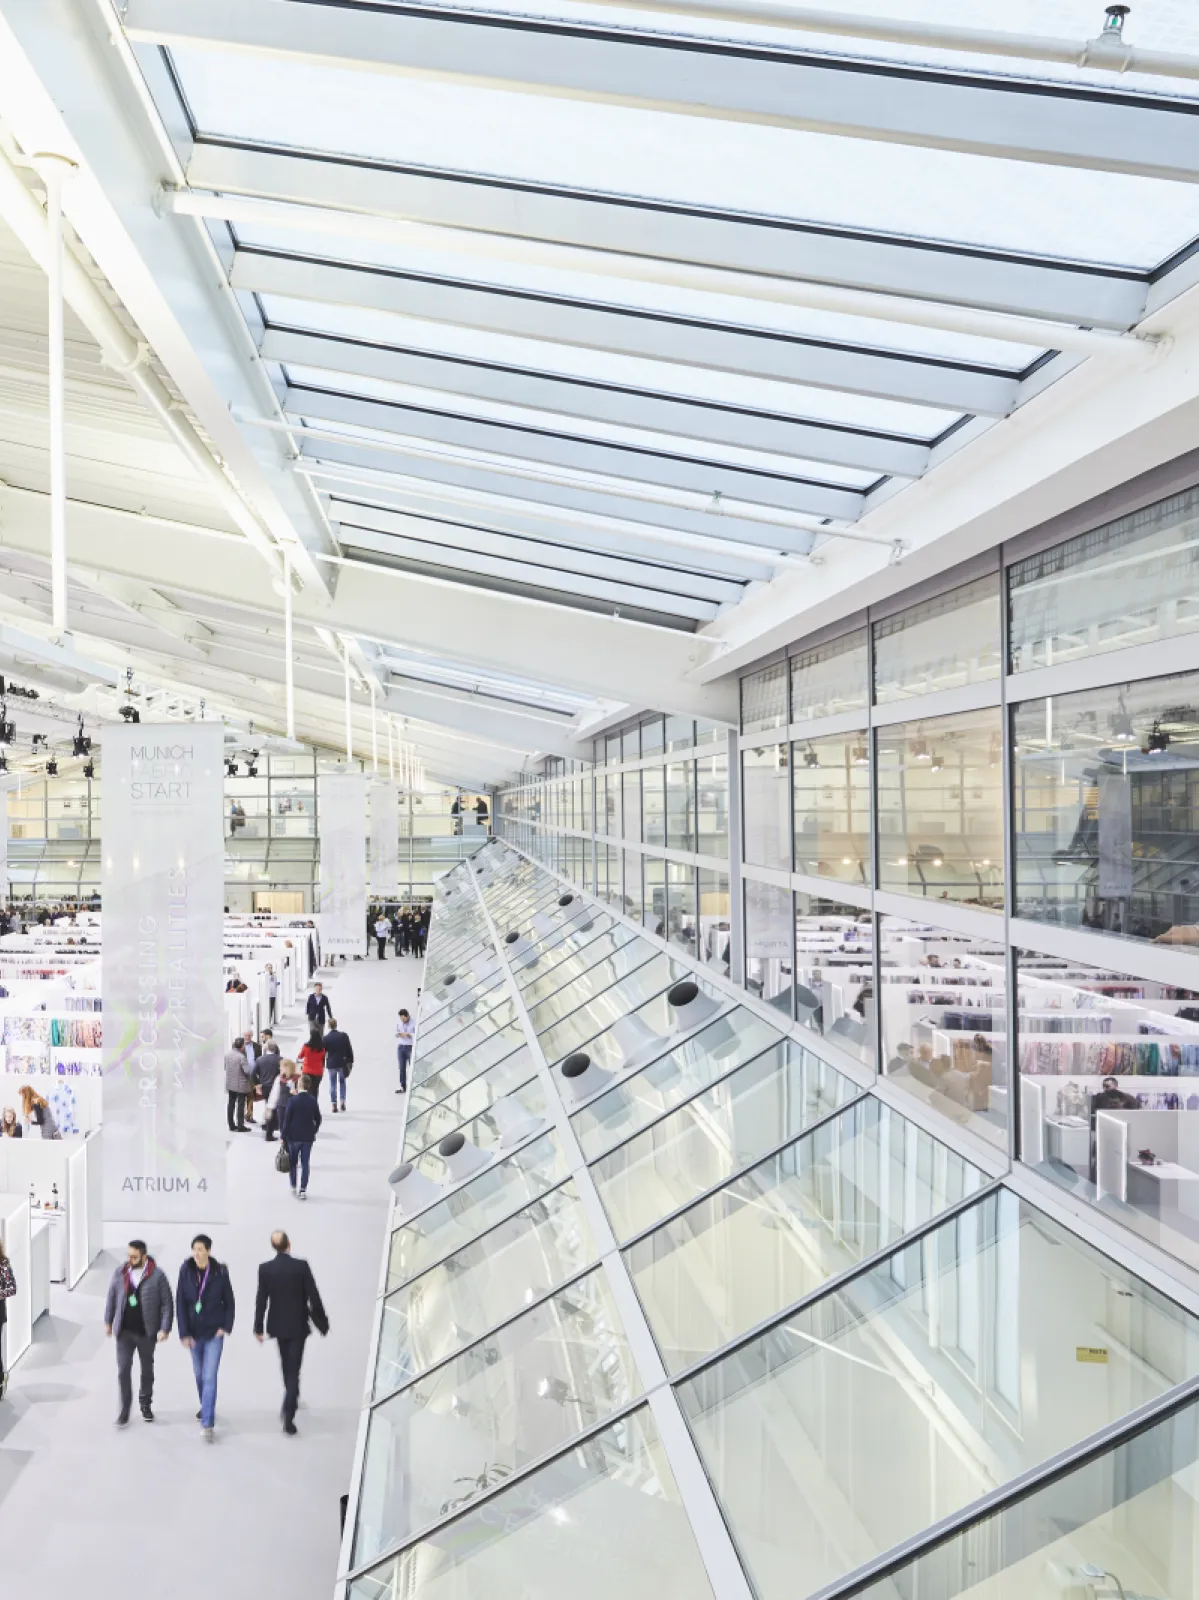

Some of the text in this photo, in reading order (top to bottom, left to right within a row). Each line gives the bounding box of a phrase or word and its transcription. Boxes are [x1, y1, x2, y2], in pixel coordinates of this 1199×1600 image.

[130, 744, 194, 761] MUNICH
[130, 782, 193, 800] START
[167, 867, 187, 1009] REALITIES
[138, 914, 158, 1108] PROCESSING
[121, 1176, 209, 1193] ATRIUM 4
